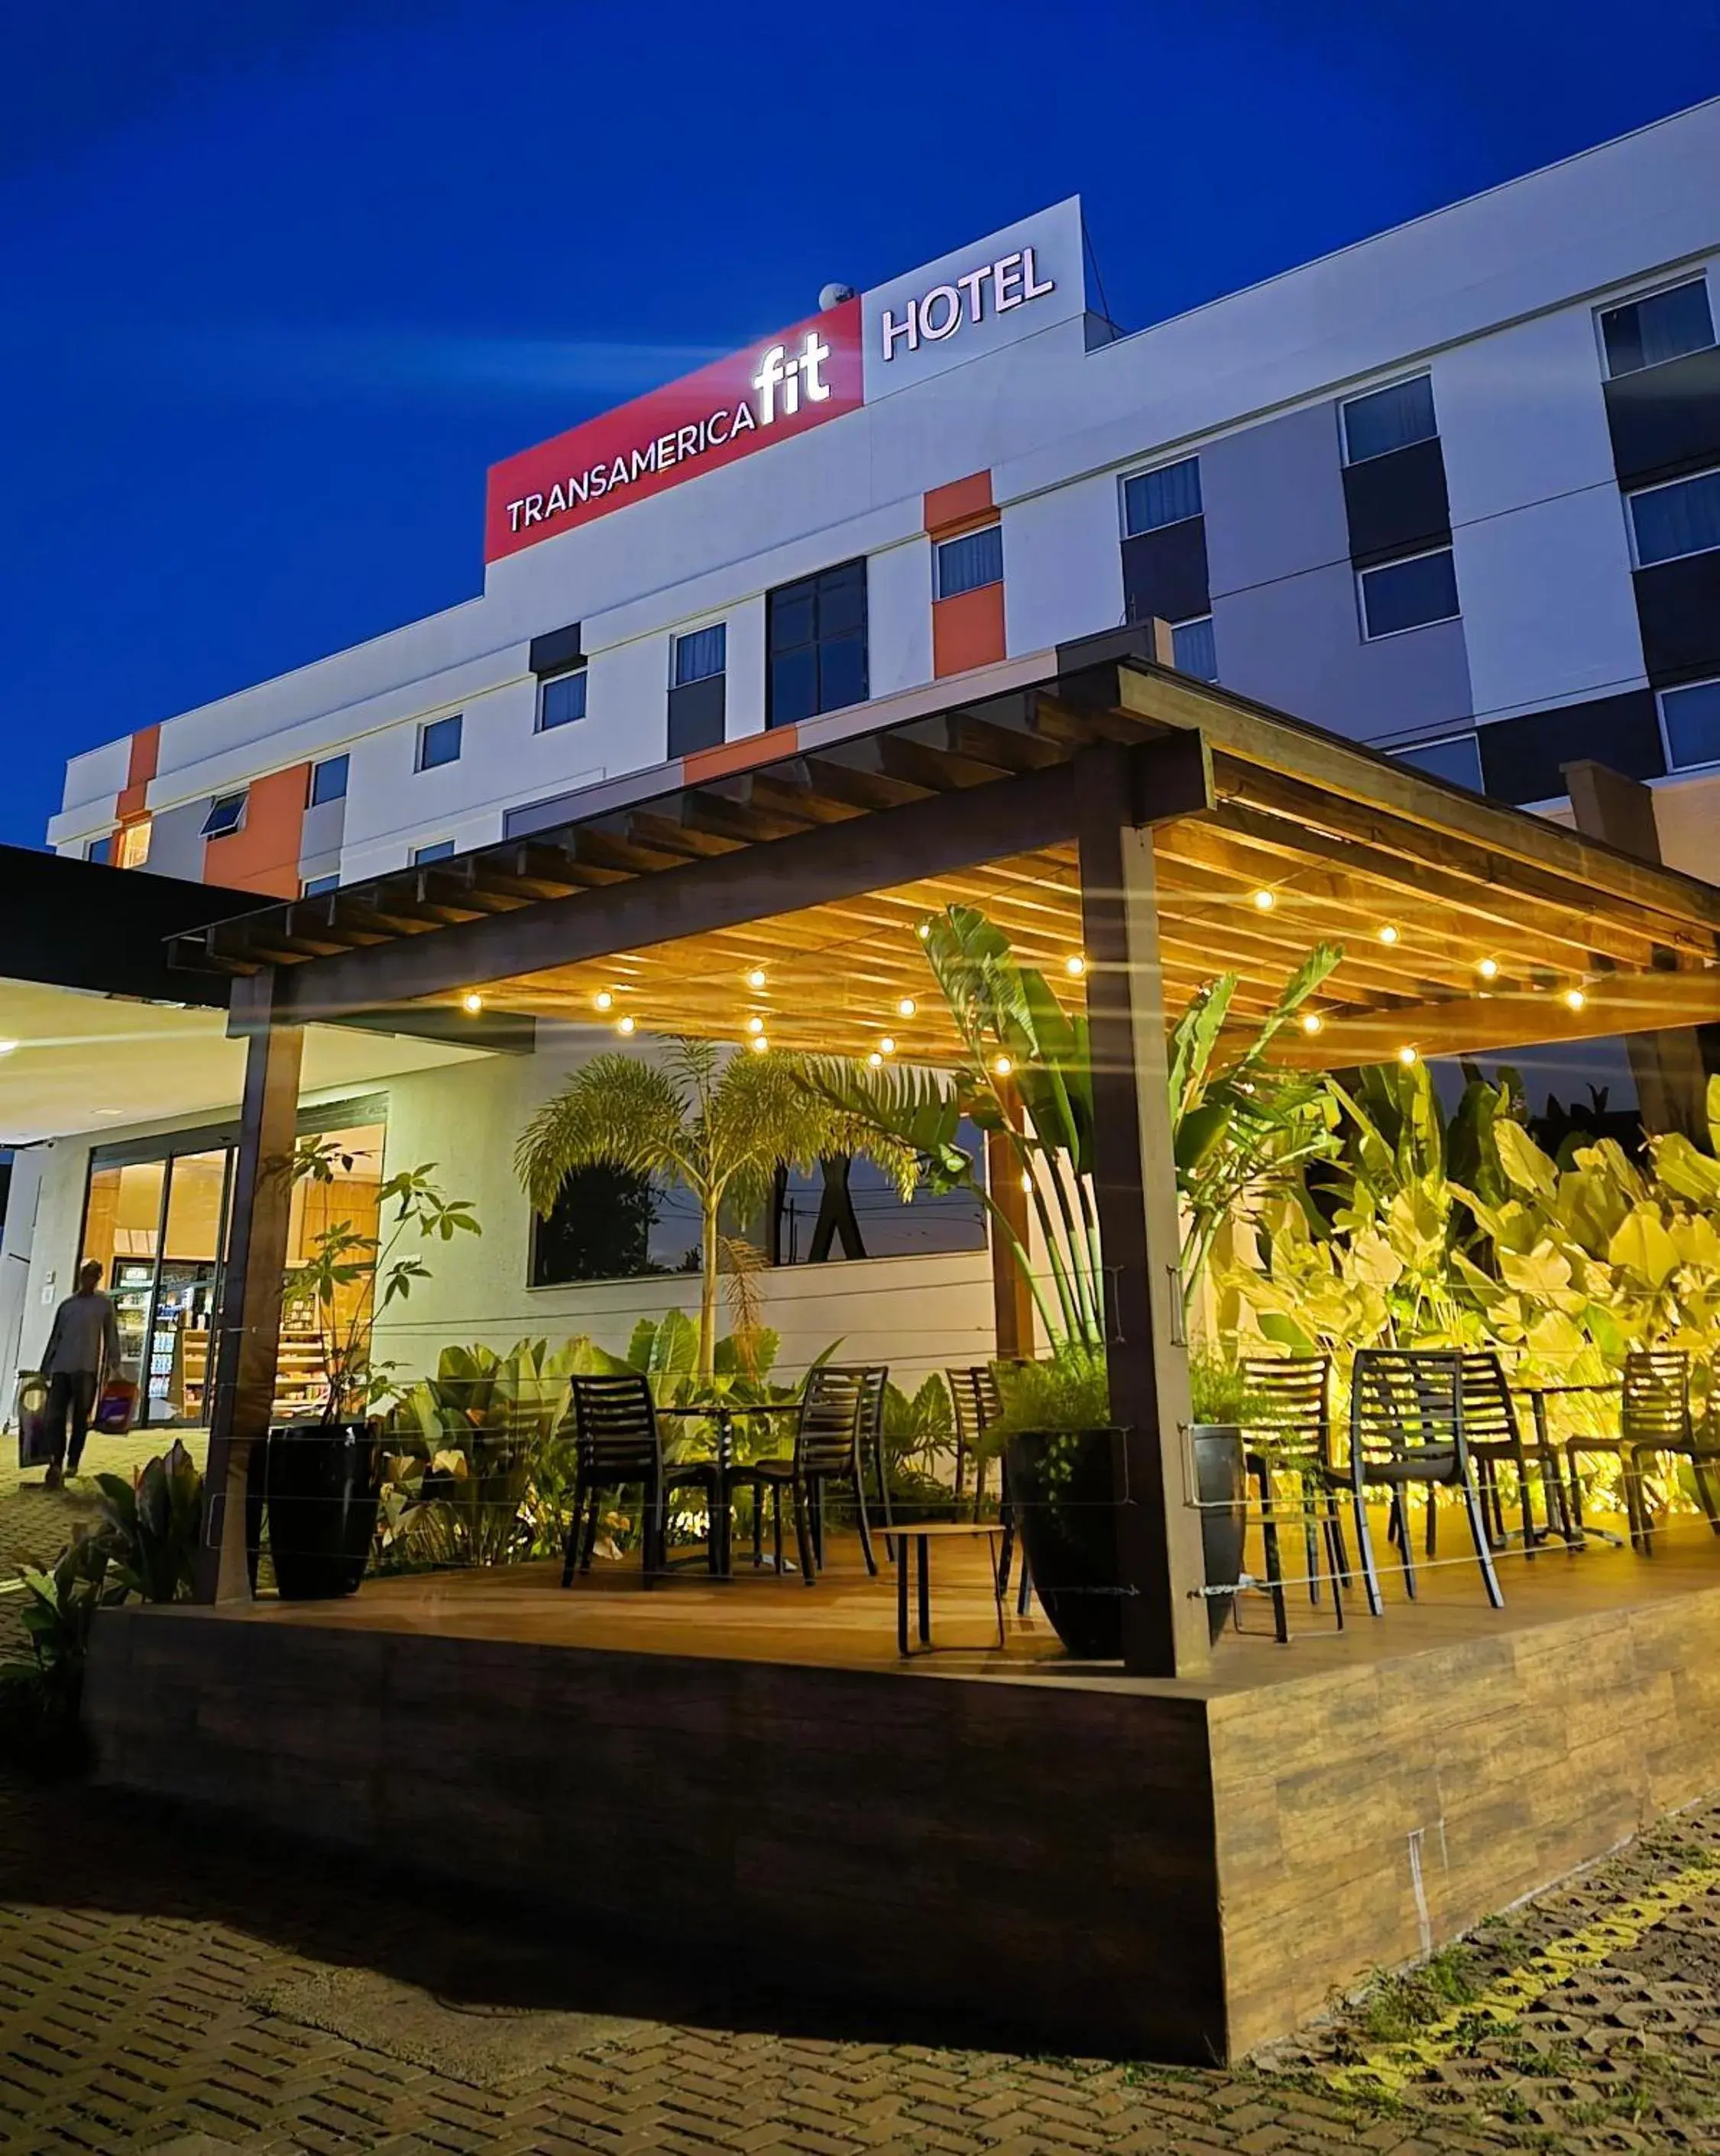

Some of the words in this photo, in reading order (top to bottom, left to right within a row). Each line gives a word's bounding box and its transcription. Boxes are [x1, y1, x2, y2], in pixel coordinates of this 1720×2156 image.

[882, 248, 1054, 361] HOTEL
[507, 401, 755, 531] TRANSAMERICA
[753, 332, 831, 425] fit
